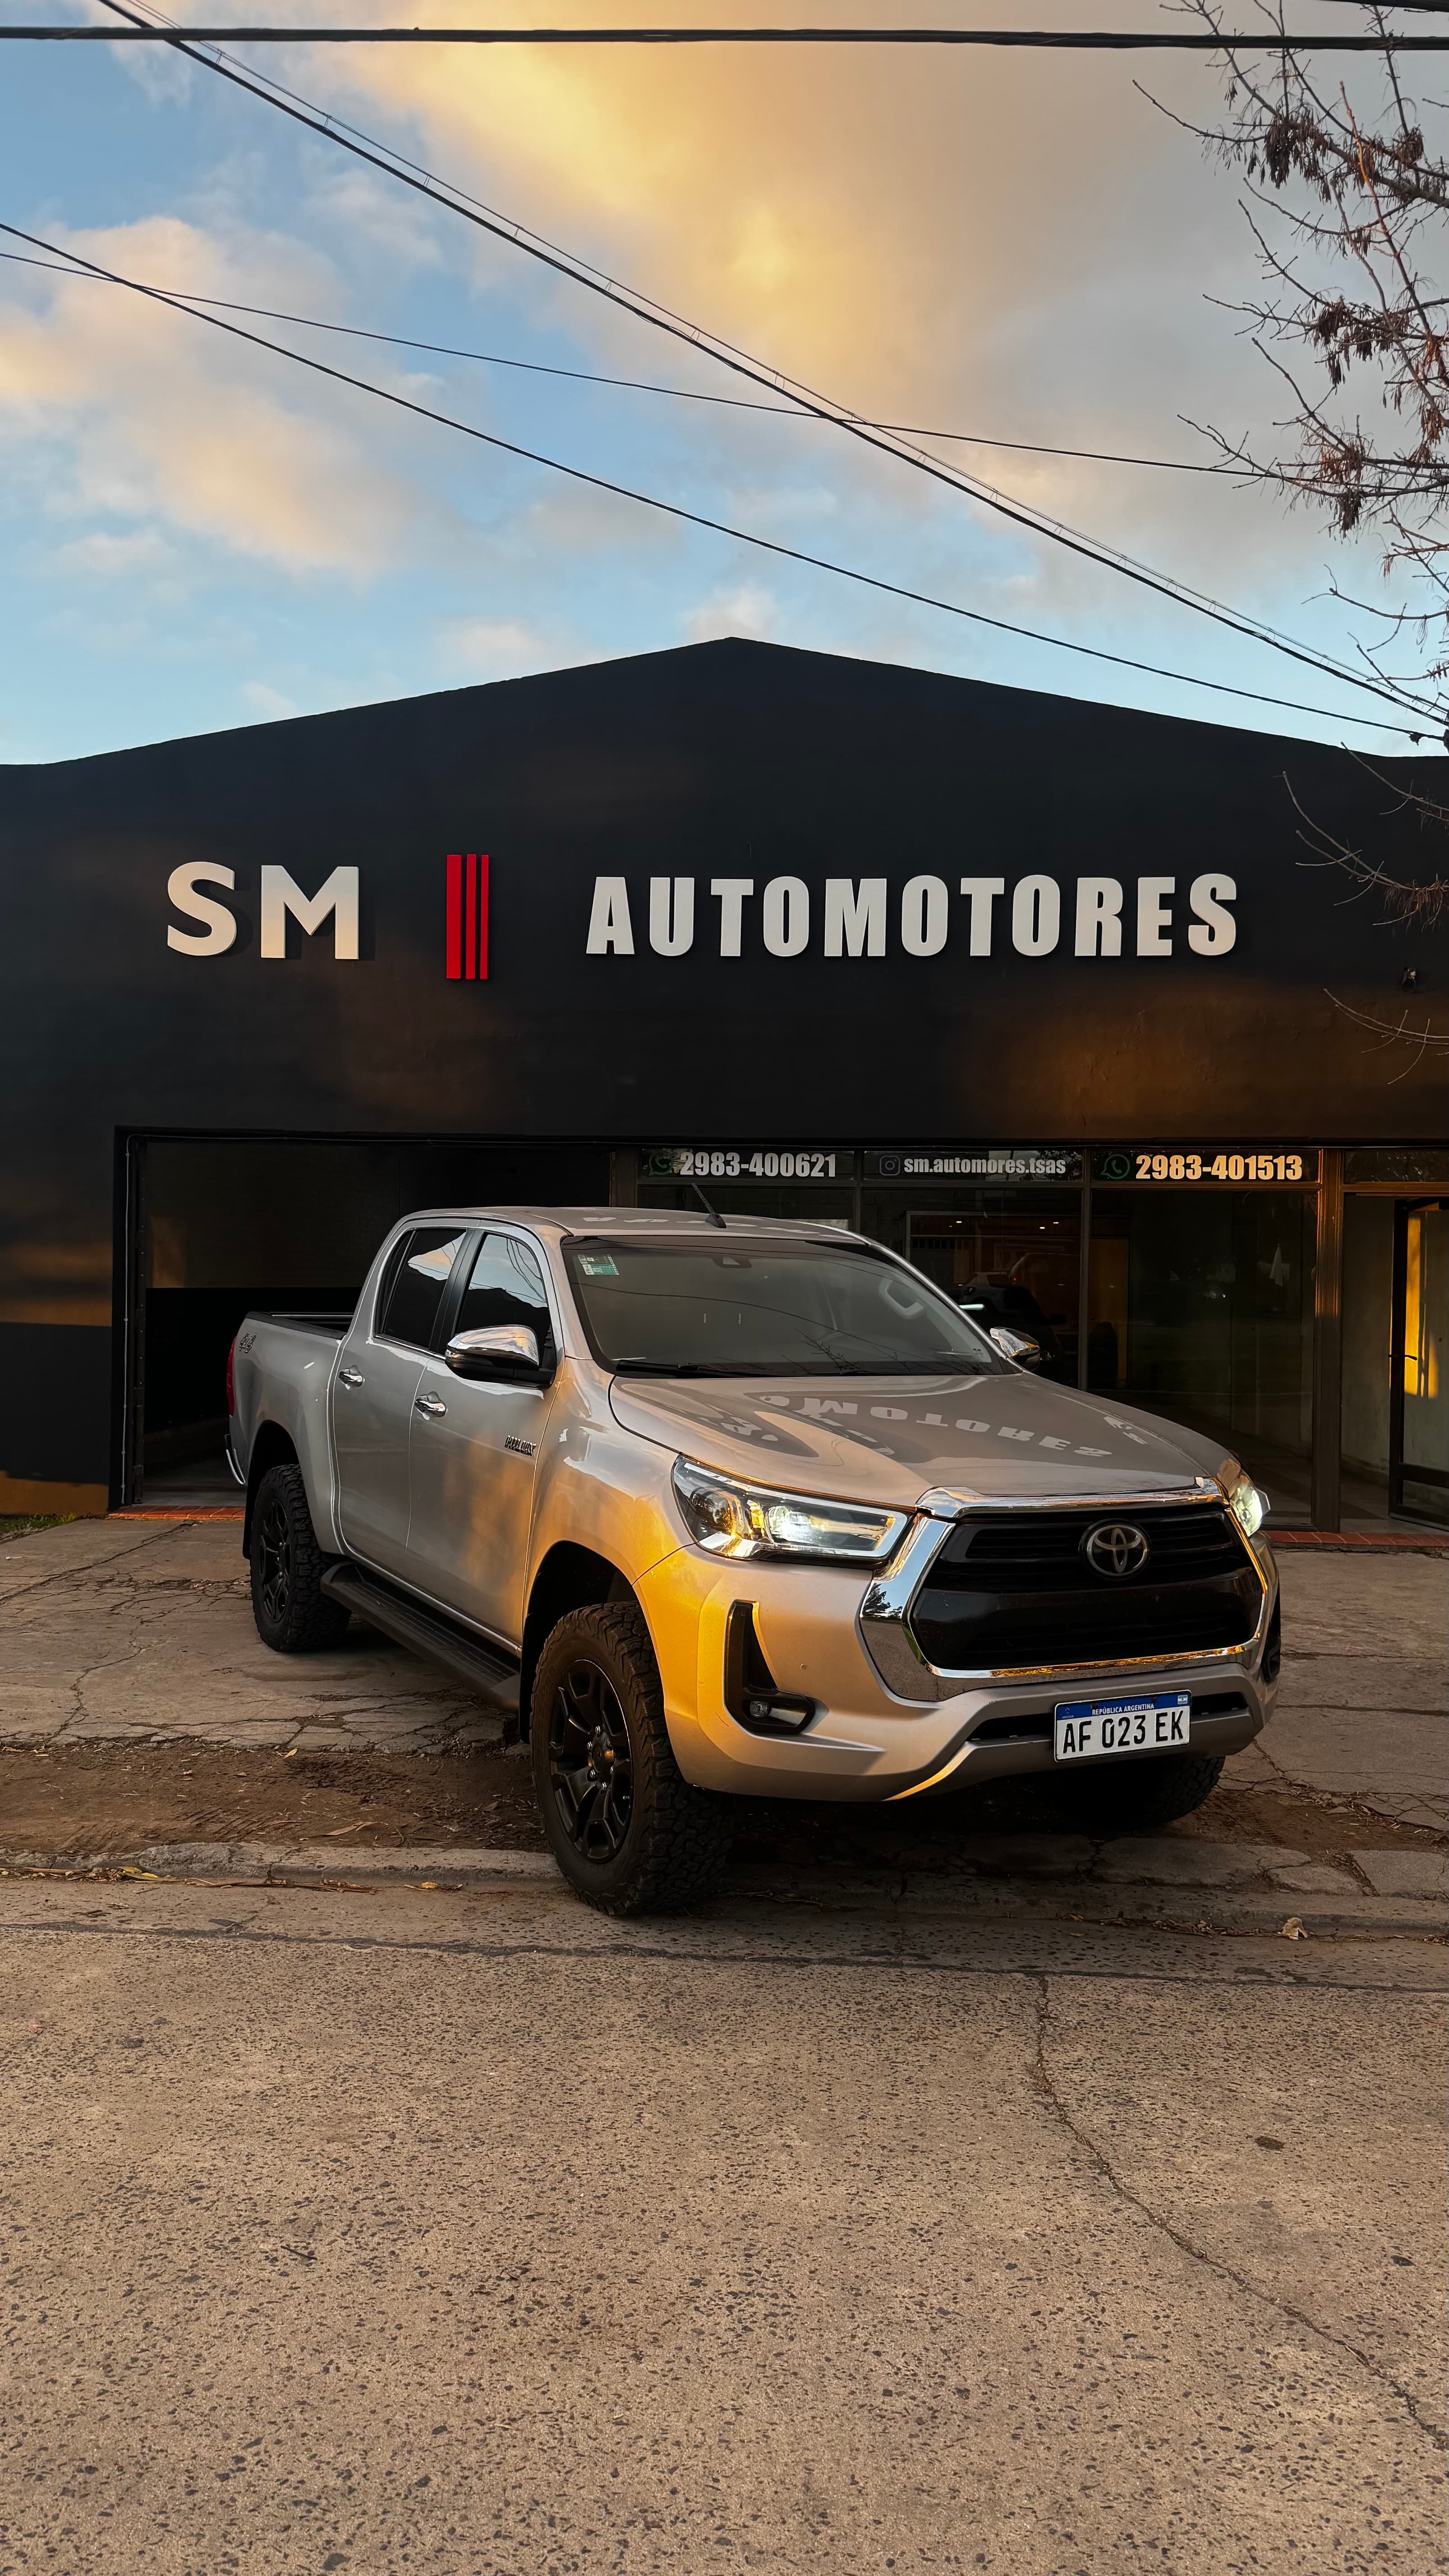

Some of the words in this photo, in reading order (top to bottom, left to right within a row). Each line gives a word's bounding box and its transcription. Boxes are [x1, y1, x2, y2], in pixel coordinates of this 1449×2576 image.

[167, 861, 359, 960] SM
[585, 873, 1237, 957] AUTOMOTORES
[680, 1152, 836, 1178] 2983-400621
[904, 1157, 1066, 1174] sm.automores.tsas
[1136, 1155, 1302, 1180] 2983-401513
[1092, 1707, 1122, 1716] REPÚBLICA
[1124, 1702, 1155, 1712] ARGENTINA
[1063, 1720, 1092, 1754] AF
[1102, 1715, 1146, 1748] 023
[1155, 1710, 1184, 1742] EK
